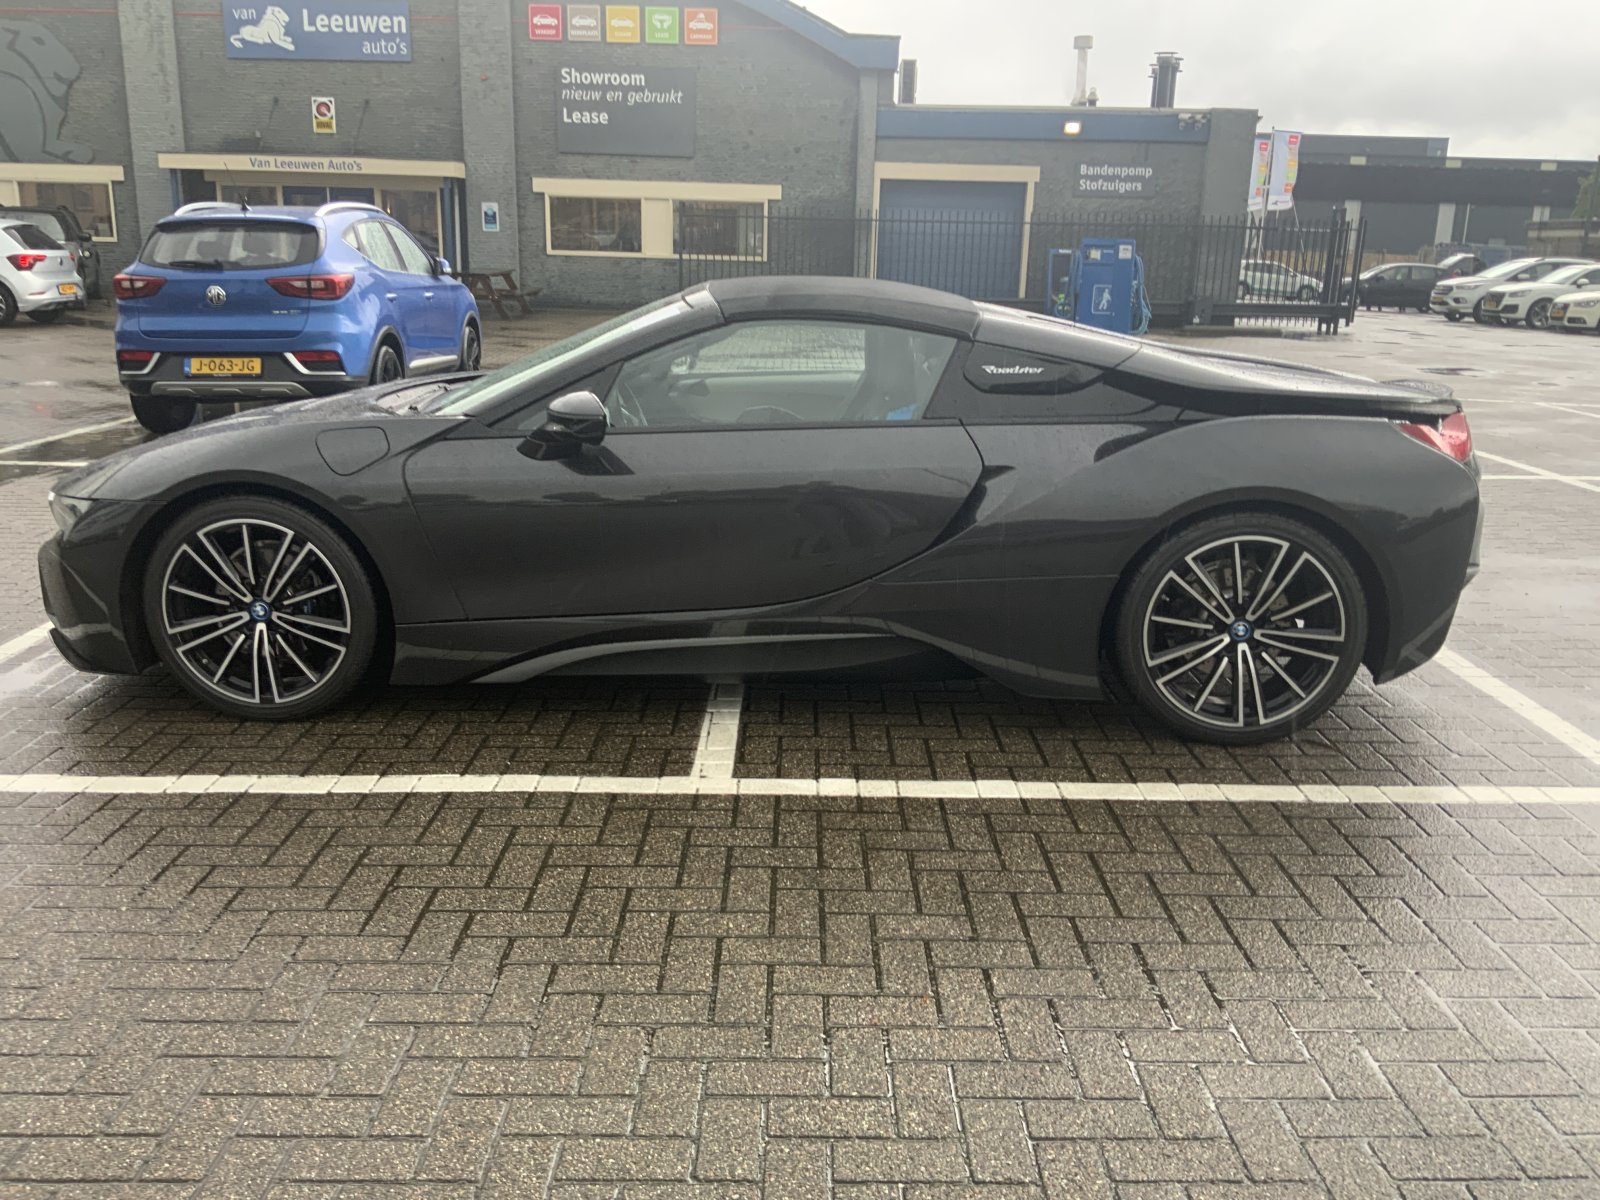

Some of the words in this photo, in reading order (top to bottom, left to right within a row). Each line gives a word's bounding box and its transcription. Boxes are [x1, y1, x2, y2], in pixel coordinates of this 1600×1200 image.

[232, 7, 257, 20] van
[302, 8, 407, 34] Leeuwen
[362, 38, 408, 55] auto's
[561, 67, 646, 86] Showroom
[561, 86, 602, 101] nieuw
[606, 89, 622, 102] en
[627, 89, 683, 105] gebruikt
[563, 107, 609, 124] Lease
[249, 157, 271, 169] Van
[274, 158, 324, 170] Leeuwen
[327, 160, 363, 172] Auto's
[1080, 164, 1153, 179] Bandenpomp
[1079, 179, 1142, 193] Stofzuigers
[196, 360, 255, 372] J-063-JG
